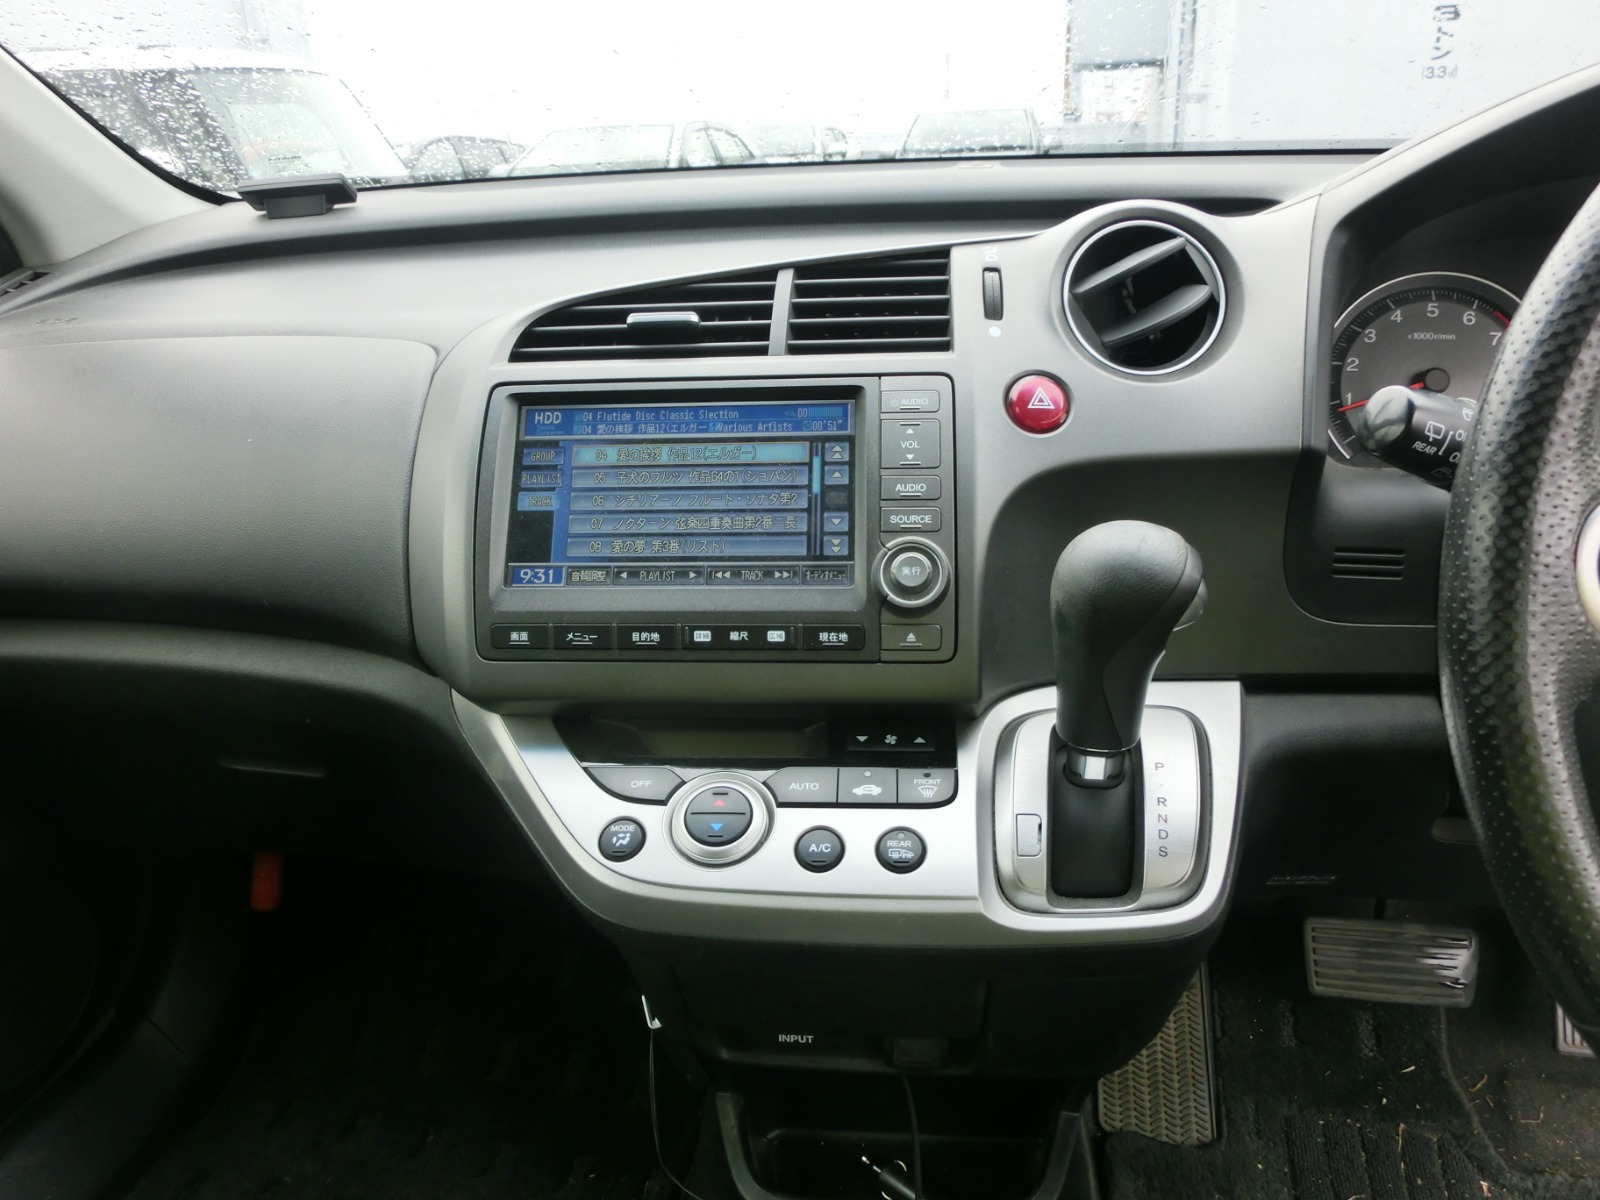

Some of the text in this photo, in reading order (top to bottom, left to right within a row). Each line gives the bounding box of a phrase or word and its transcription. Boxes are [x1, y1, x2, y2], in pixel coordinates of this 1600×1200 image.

[1426, 303, 1439, 317] 5
[1390, 310, 1403, 323] 4
[1462, 311, 1476, 326] 6
[1364, 329, 1376, 343] 3
[1489, 332, 1502, 346] 7
[1346, 357, 1359, 372] 2
[900, 397, 929, 406] AUDIO
[534, 411, 562, 424] HDD
[583, 409, 739, 422] 04 Flutide Disc Classic Slection
[797, 407, 808, 418] 00
[582, 424, 592, 435] 04
[757, 420, 793, 431] Artists
[900, 440, 920, 448] VOL
[1412, 441, 1437, 455] REAR
[530, 452, 556, 463] GROUP
[595, 450, 608, 462] 04
[522, 473, 561, 485] PLAYLIST
[593, 472, 606, 484] 05
[895, 484, 927, 493] AUDIO
[591, 518, 604, 530] 07
[613, 517, 670, 531] ノクターン
[889, 515, 933, 524] SOURCE
[519, 568, 554, 583] 9:31
[639, 571, 676, 582] PLAYLIST
[741, 571, 764, 580] TRACK
[901, 566, 921, 576] 実行
[510, 631, 529, 641] 画面
[566, 632, 598, 641] メニュー
[632, 632, 661, 642] 目的地
[729, 631, 748, 641] 縮尺
[818, 632, 849, 642] 現在地
[1155, 762, 1165, 771] P
[631, 780, 653, 788] OFF
[789, 782, 819, 791] AUTO
[1157, 797, 1167, 807] R
[1158, 813, 1168, 824] N
[1158, 829, 1169, 840] D
[808, 844, 832, 853] A/C
[887, 840, 912, 848] REAR
[1158, 846, 1168, 857] S
[778, 1034, 814, 1044] INPUT
